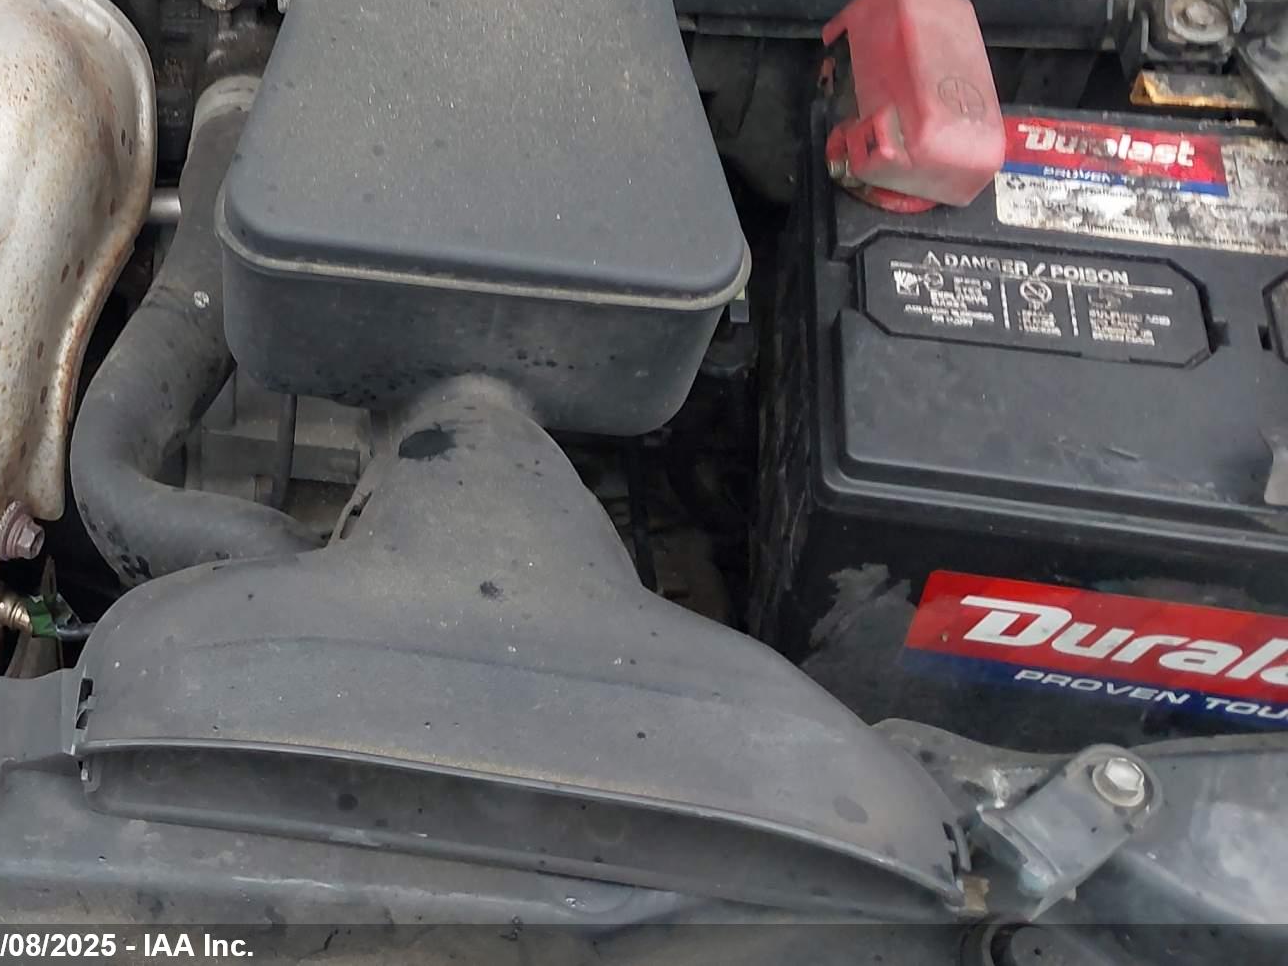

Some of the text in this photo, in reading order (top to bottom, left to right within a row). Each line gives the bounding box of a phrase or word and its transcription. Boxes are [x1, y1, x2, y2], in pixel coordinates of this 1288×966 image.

[1017, 123, 1196, 167] Duralast
[1050, 264, 1129, 285] POISON
[1013, 668, 1191, 706] PROVEN
